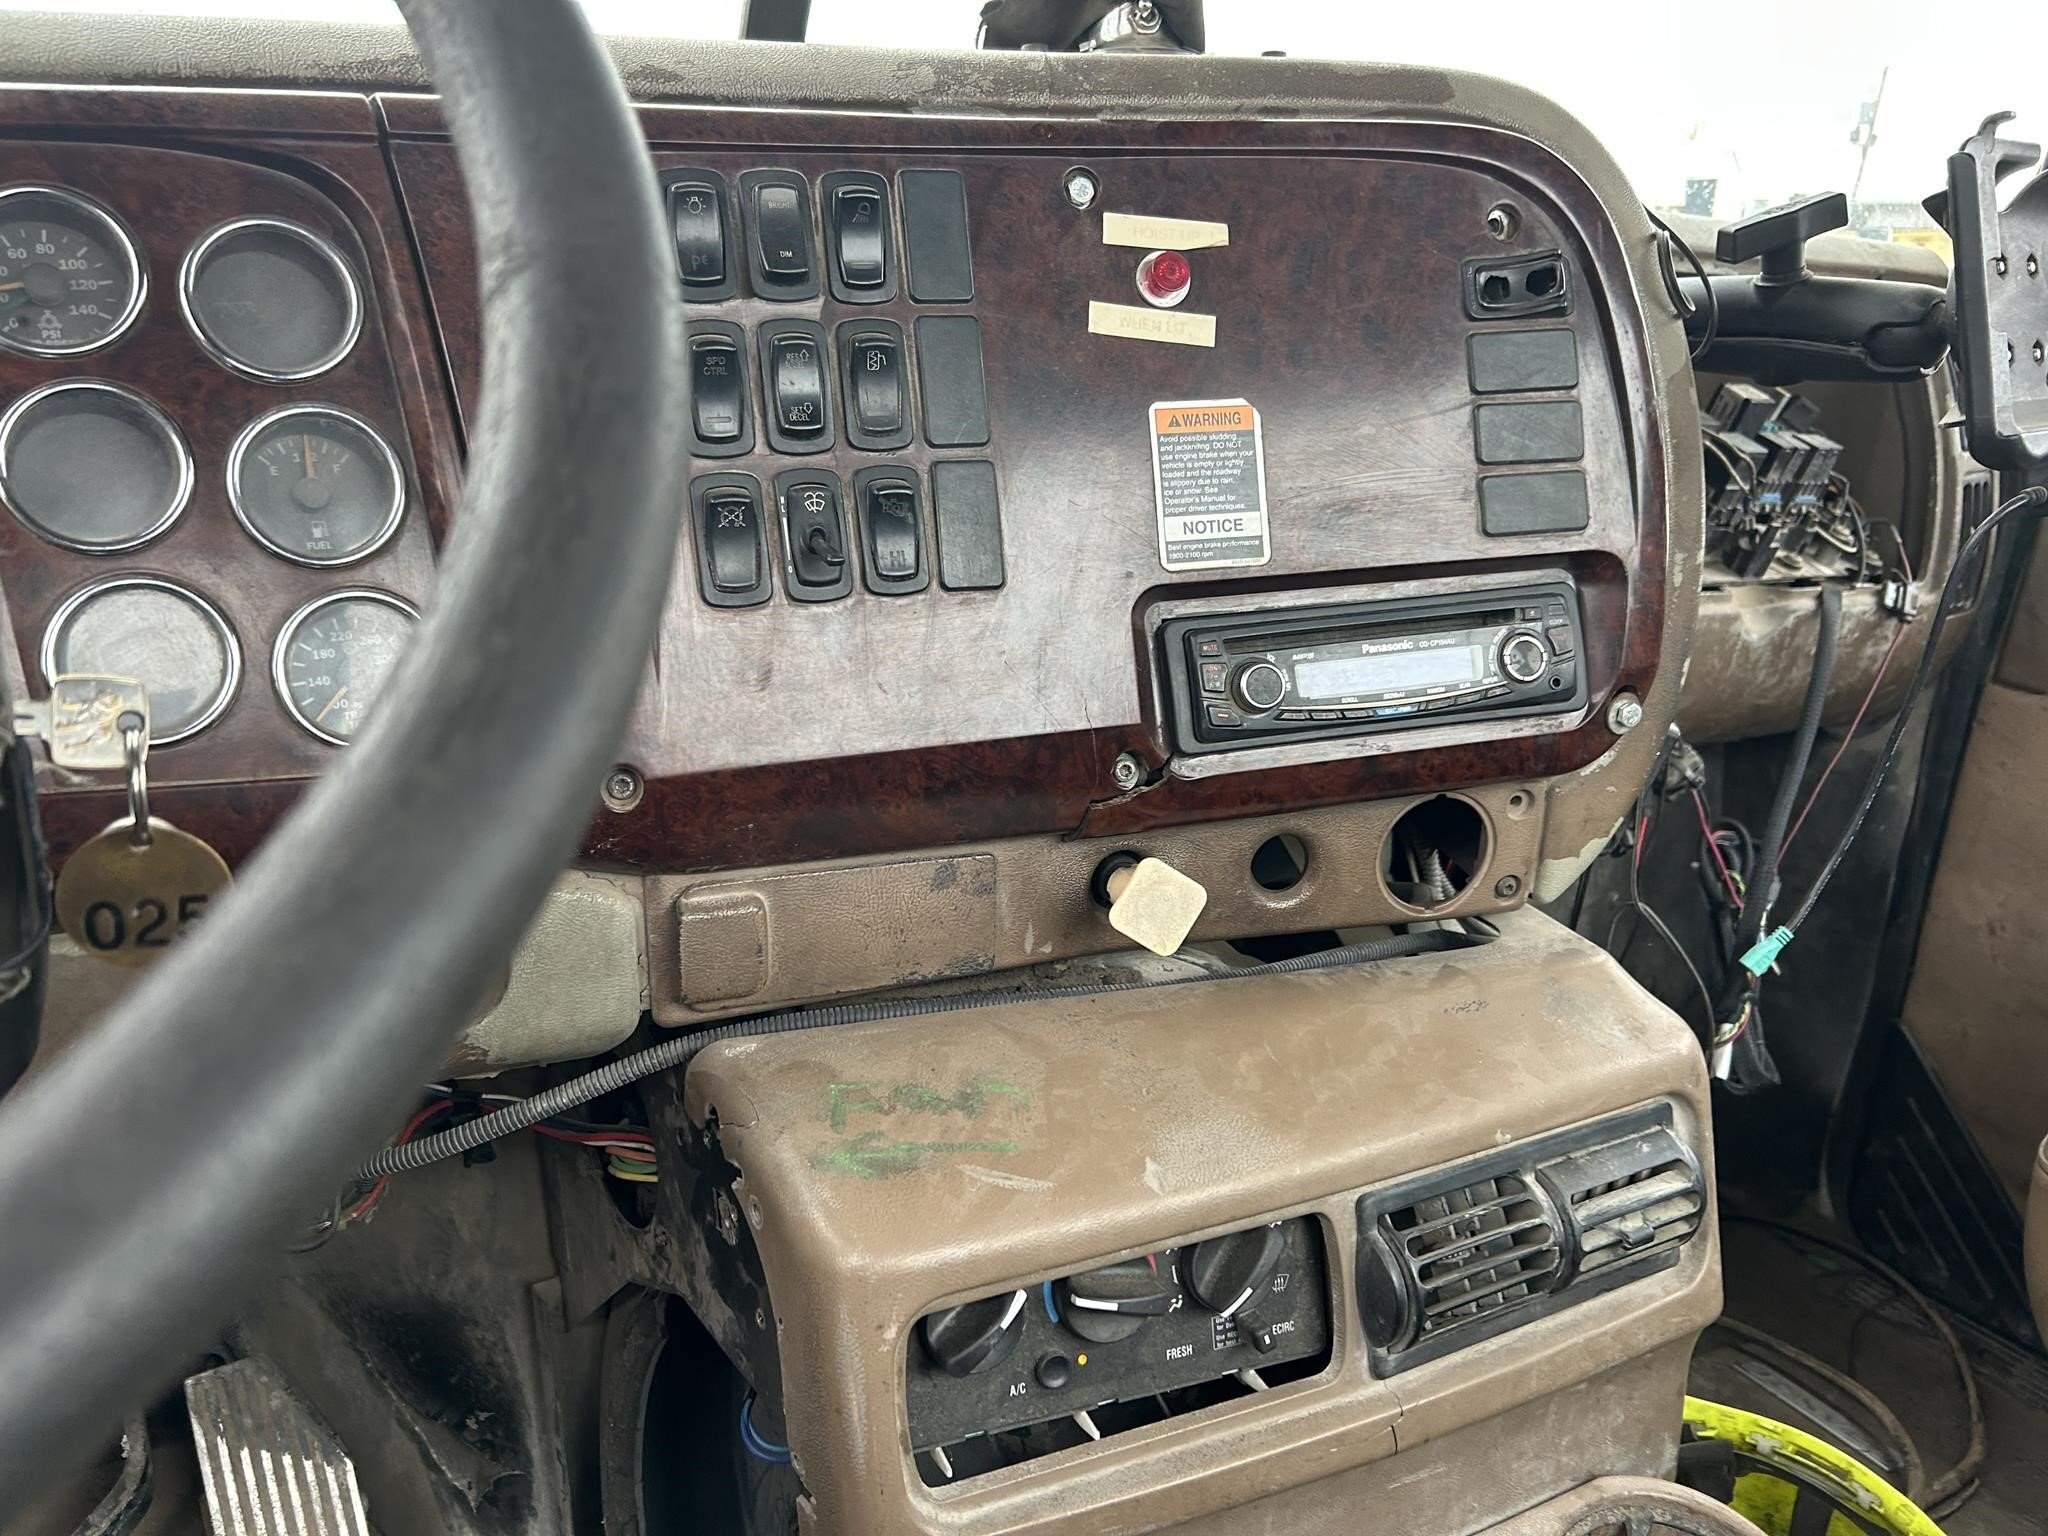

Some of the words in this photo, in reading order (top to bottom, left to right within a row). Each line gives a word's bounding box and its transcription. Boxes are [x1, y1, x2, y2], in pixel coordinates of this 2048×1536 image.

[7, 248, 27, 259] 60
[35, 243, 55, 254] 80
[779, 250, 793, 258] DIM
[59, 259, 87, 270] 100
[69, 280, 97, 290] 120
[69, 304, 97, 315] 140
[42, 331, 61, 339] PSI
[706, 356, 725, 365] SPD
[703, 366, 728, 375] CTRL
[789, 413, 810, 421] DECEL
[1182, 411, 1242, 427] WARNING
[1160, 435, 1178, 443] Avoid
[1179, 434, 1207, 443] possible
[1209, 433, 1236, 441] skidding
[1175, 453, 1197, 461] engine
[1199, 451, 1217, 459] brake
[1239, 450, 1253, 459] your
[332, 463, 341, 473] F
[1194, 460, 1215, 469] empty
[1225, 459, 1244, 467] lightly
[269, 465, 279, 476] E
[1213, 468, 1241, 477] roadway
[1170, 479, 1196, 488] slippery
[1164, 488, 1173, 496] ice
[1204, 486, 1218, 494] See
[1164, 496, 1199, 505] Operator's
[1201, 495, 1226, 503] Manual
[1165, 506, 1186, 514] proper
[1183, 518, 1244, 535] NOTICE
[306, 541, 333, 550] FUEL
[1183, 543, 1203, 551] engine
[1204, 541, 1221, 549] brake
[1222, 540, 1260, 548] performance
[329, 631, 352, 642] 220
[1362, 640, 1414, 654] Panasonic
[312, 648, 336, 660] 180
[308, 675, 331, 687] 140
[1272, 1320, 1295, 1335] ECIRC
[1166, 1344, 1193, 1360] FRESH
[1009, 1382, 1026, 1397] A/C
